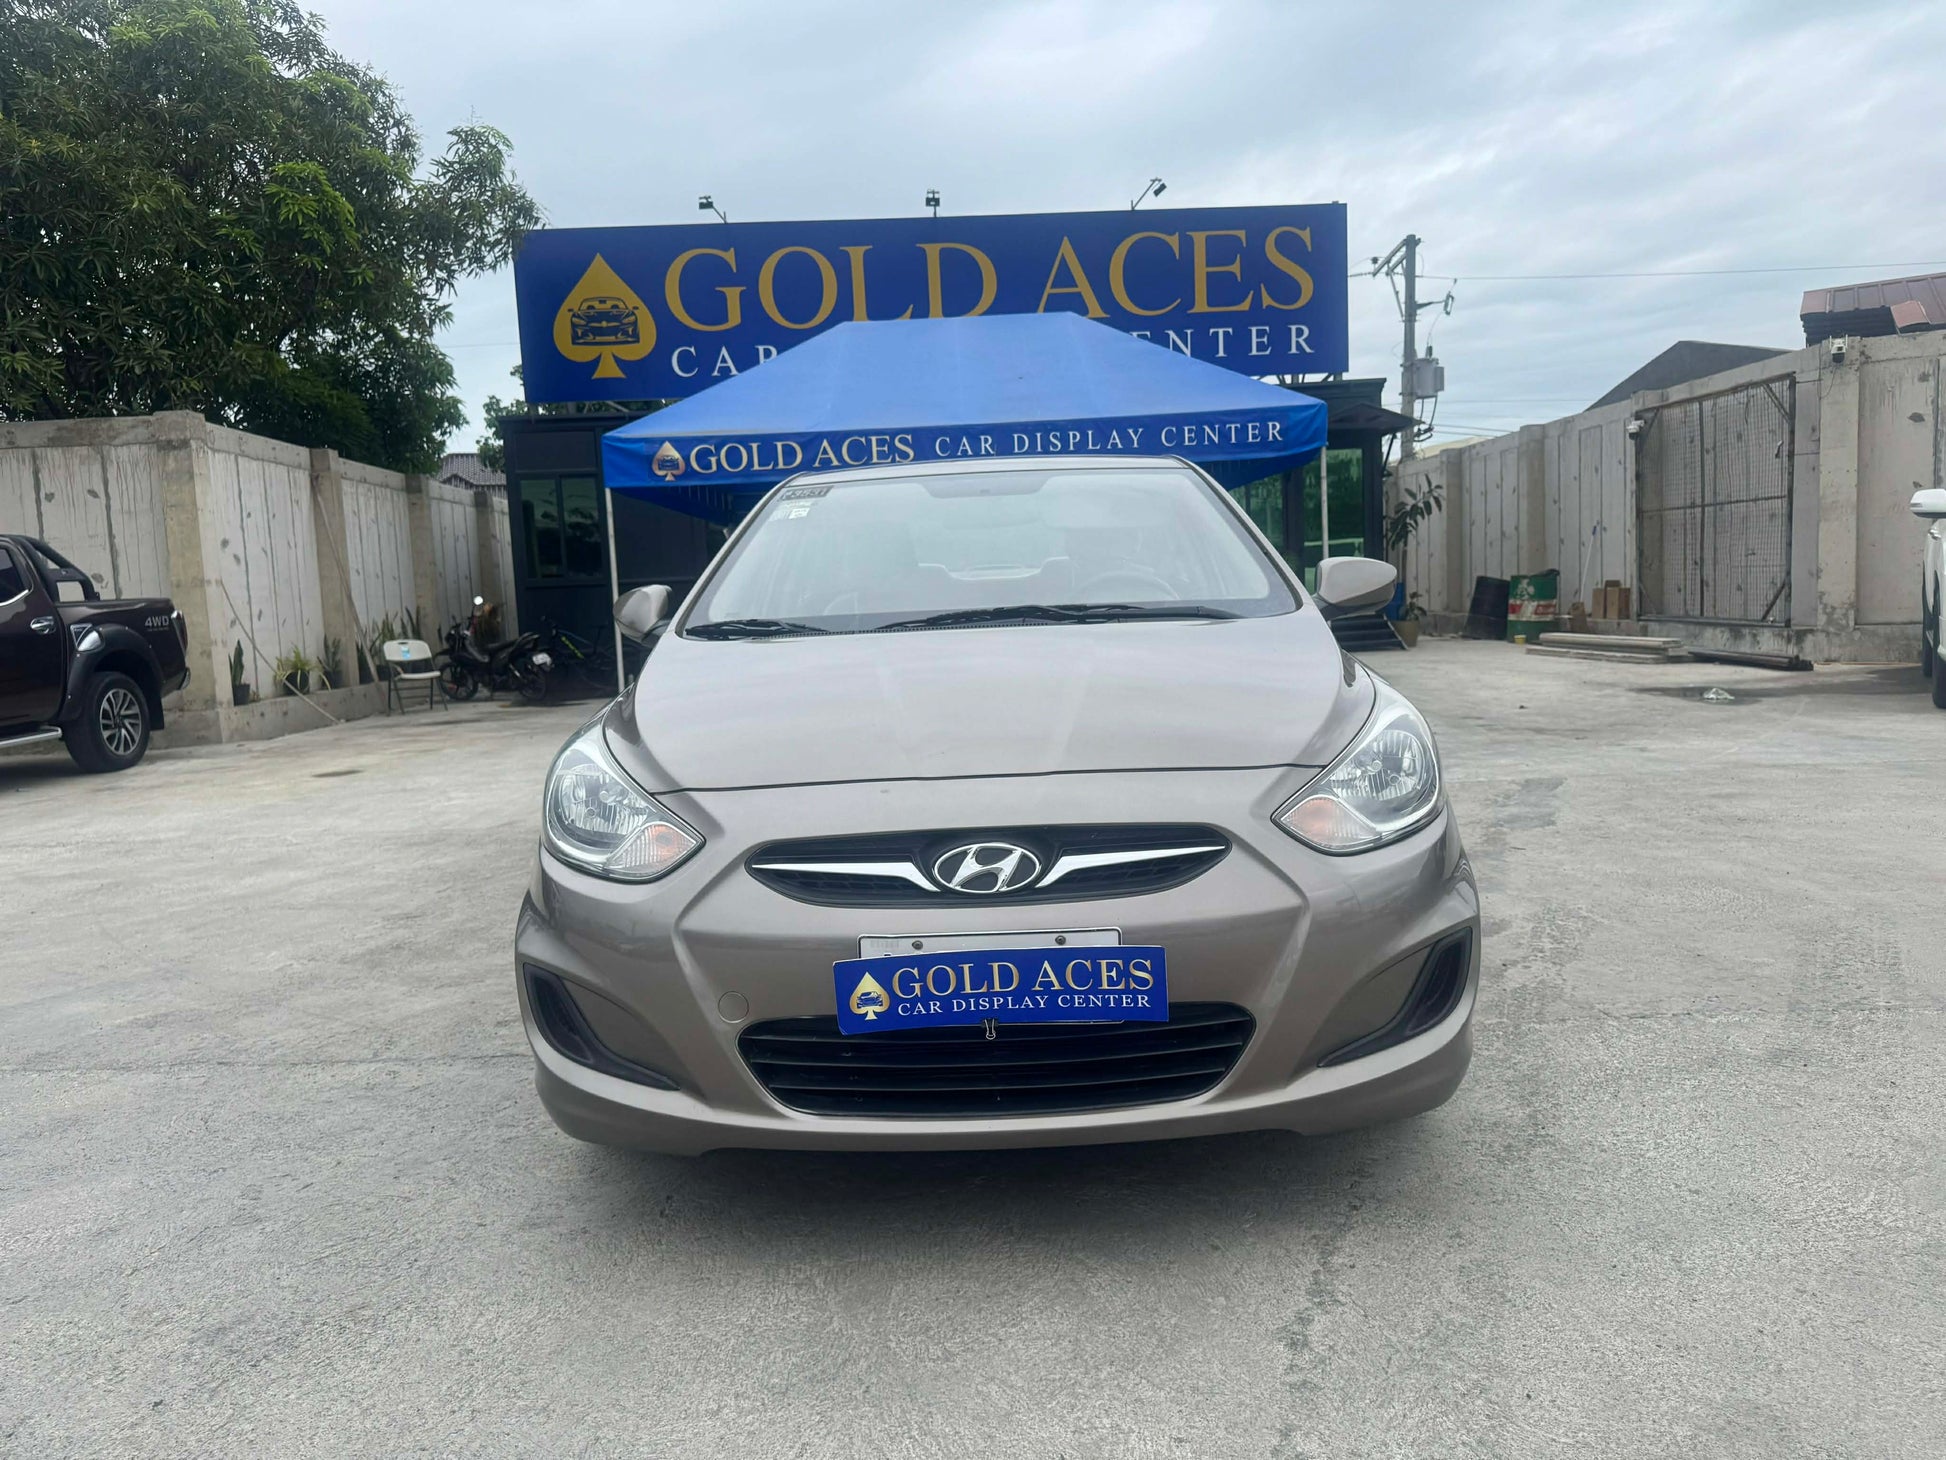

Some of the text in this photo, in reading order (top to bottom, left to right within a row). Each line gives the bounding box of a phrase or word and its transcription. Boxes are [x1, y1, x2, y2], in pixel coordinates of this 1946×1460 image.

[664, 226, 1315, 332] GOLD ACES
[1130, 324, 1315, 357] NTER
[689, 421, 1284, 474] GOLD ACES CAR DISPLAY CENTER
[144, 615, 170, 627] 4WD
[892, 959, 1155, 998] GOLD ACES
[898, 994, 1152, 1016] CAR DISPLAY CENTER
